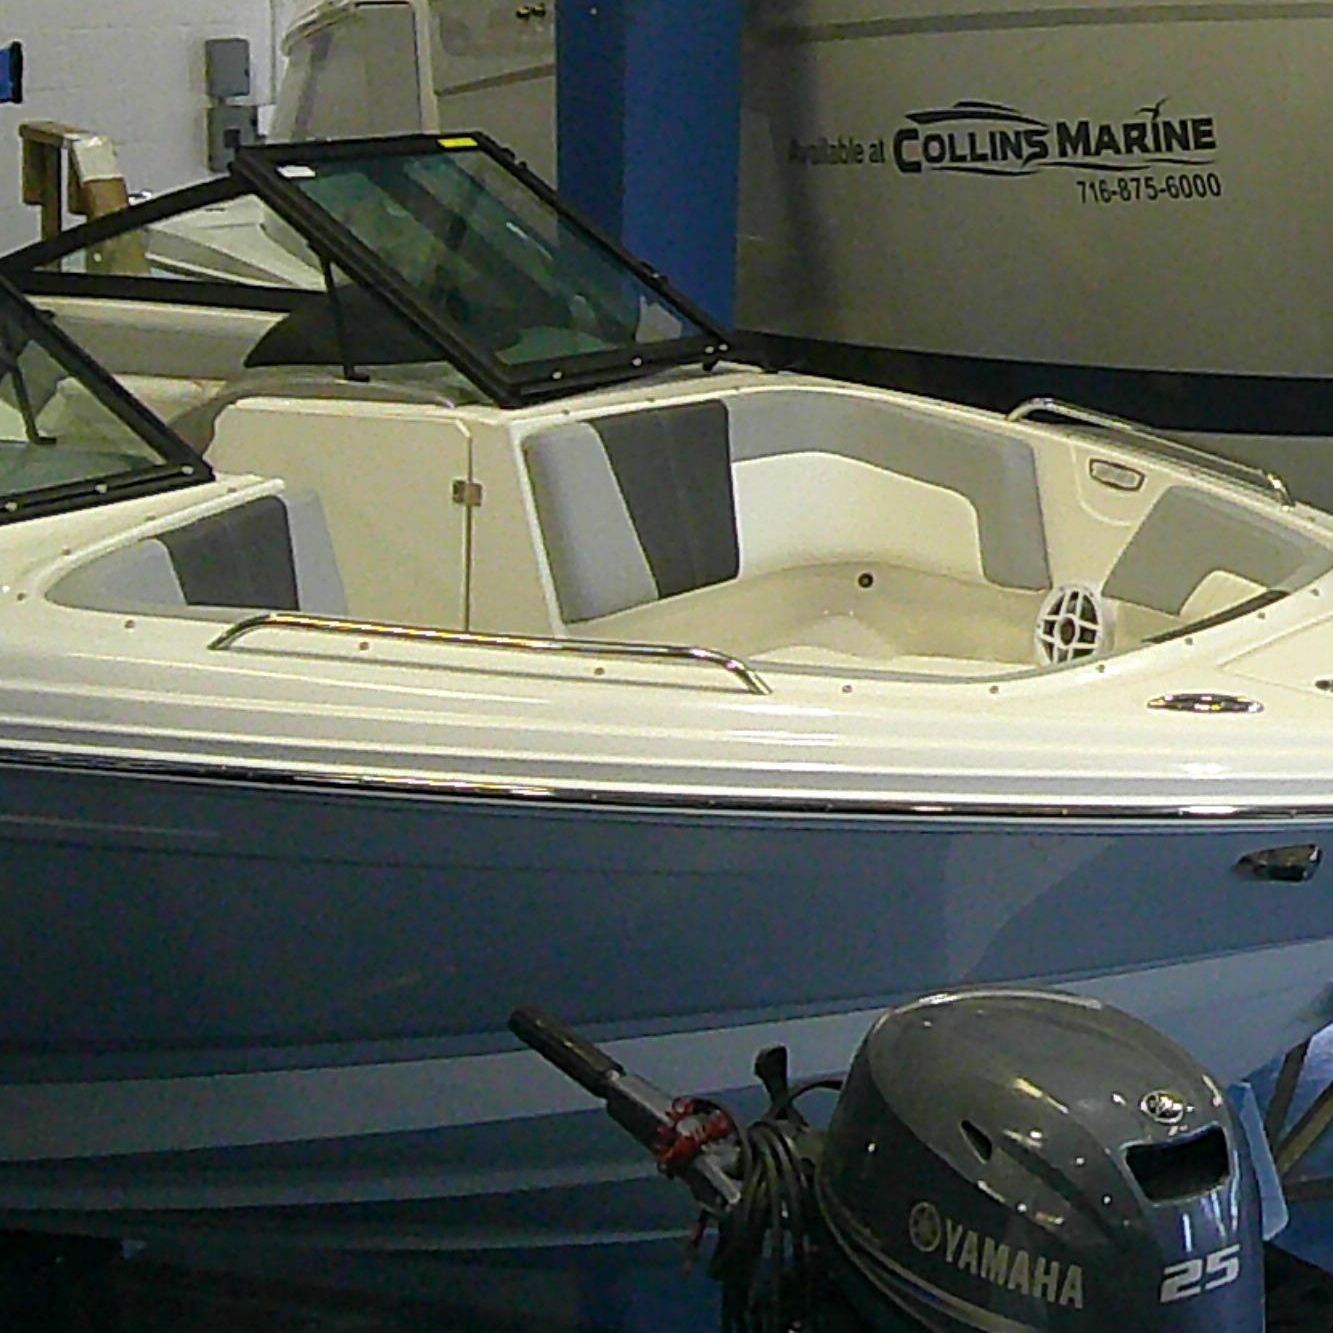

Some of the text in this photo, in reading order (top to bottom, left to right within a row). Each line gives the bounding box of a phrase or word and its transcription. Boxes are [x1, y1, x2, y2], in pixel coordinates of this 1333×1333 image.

[869, 138, 886, 163] at
[893, 127, 1050, 174] COLLINS
[1056, 117, 1217, 158] MARINE
[1077, 172, 1221, 205] 716-875-6000
[945, 1219, 1083, 1309] YAMAHA
[1160, 1243, 1240, 1303] 25
